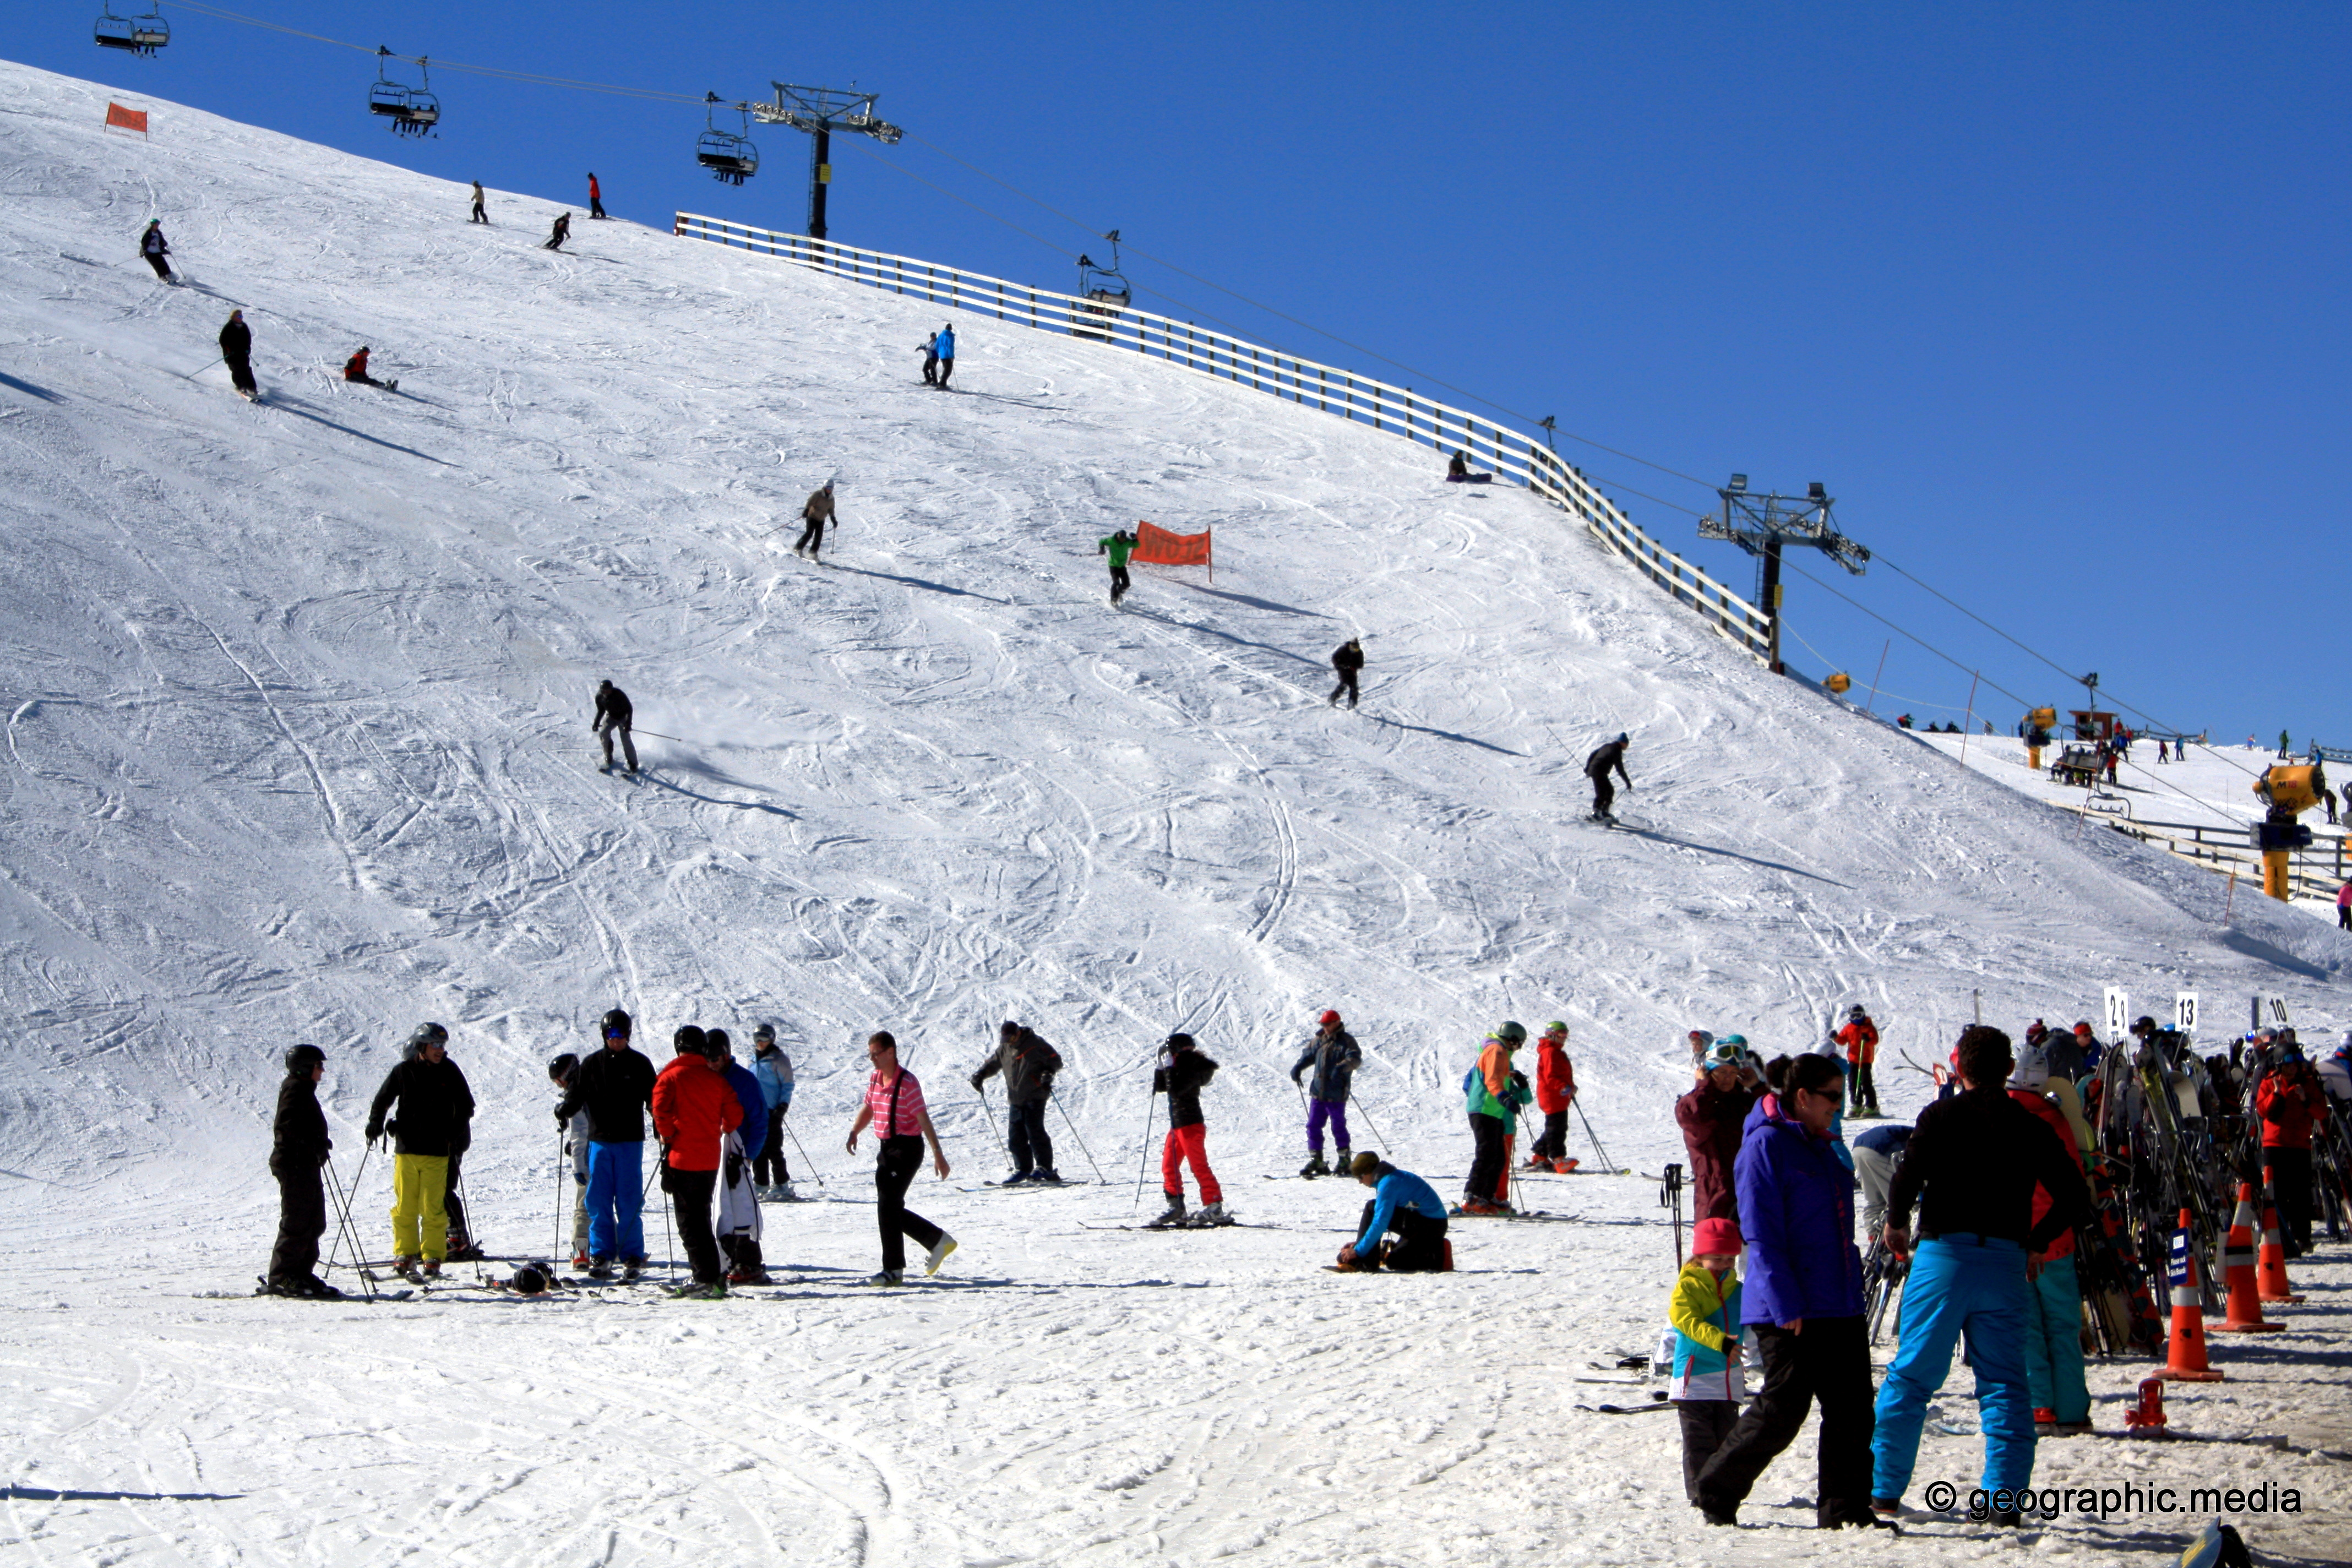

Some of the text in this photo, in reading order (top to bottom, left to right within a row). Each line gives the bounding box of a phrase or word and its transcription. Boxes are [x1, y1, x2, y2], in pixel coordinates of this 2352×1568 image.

[2110, 994, 2117, 1027] 2
[2179, 999, 2193, 1026] 13
[2269, 998, 2287, 1022] 10
